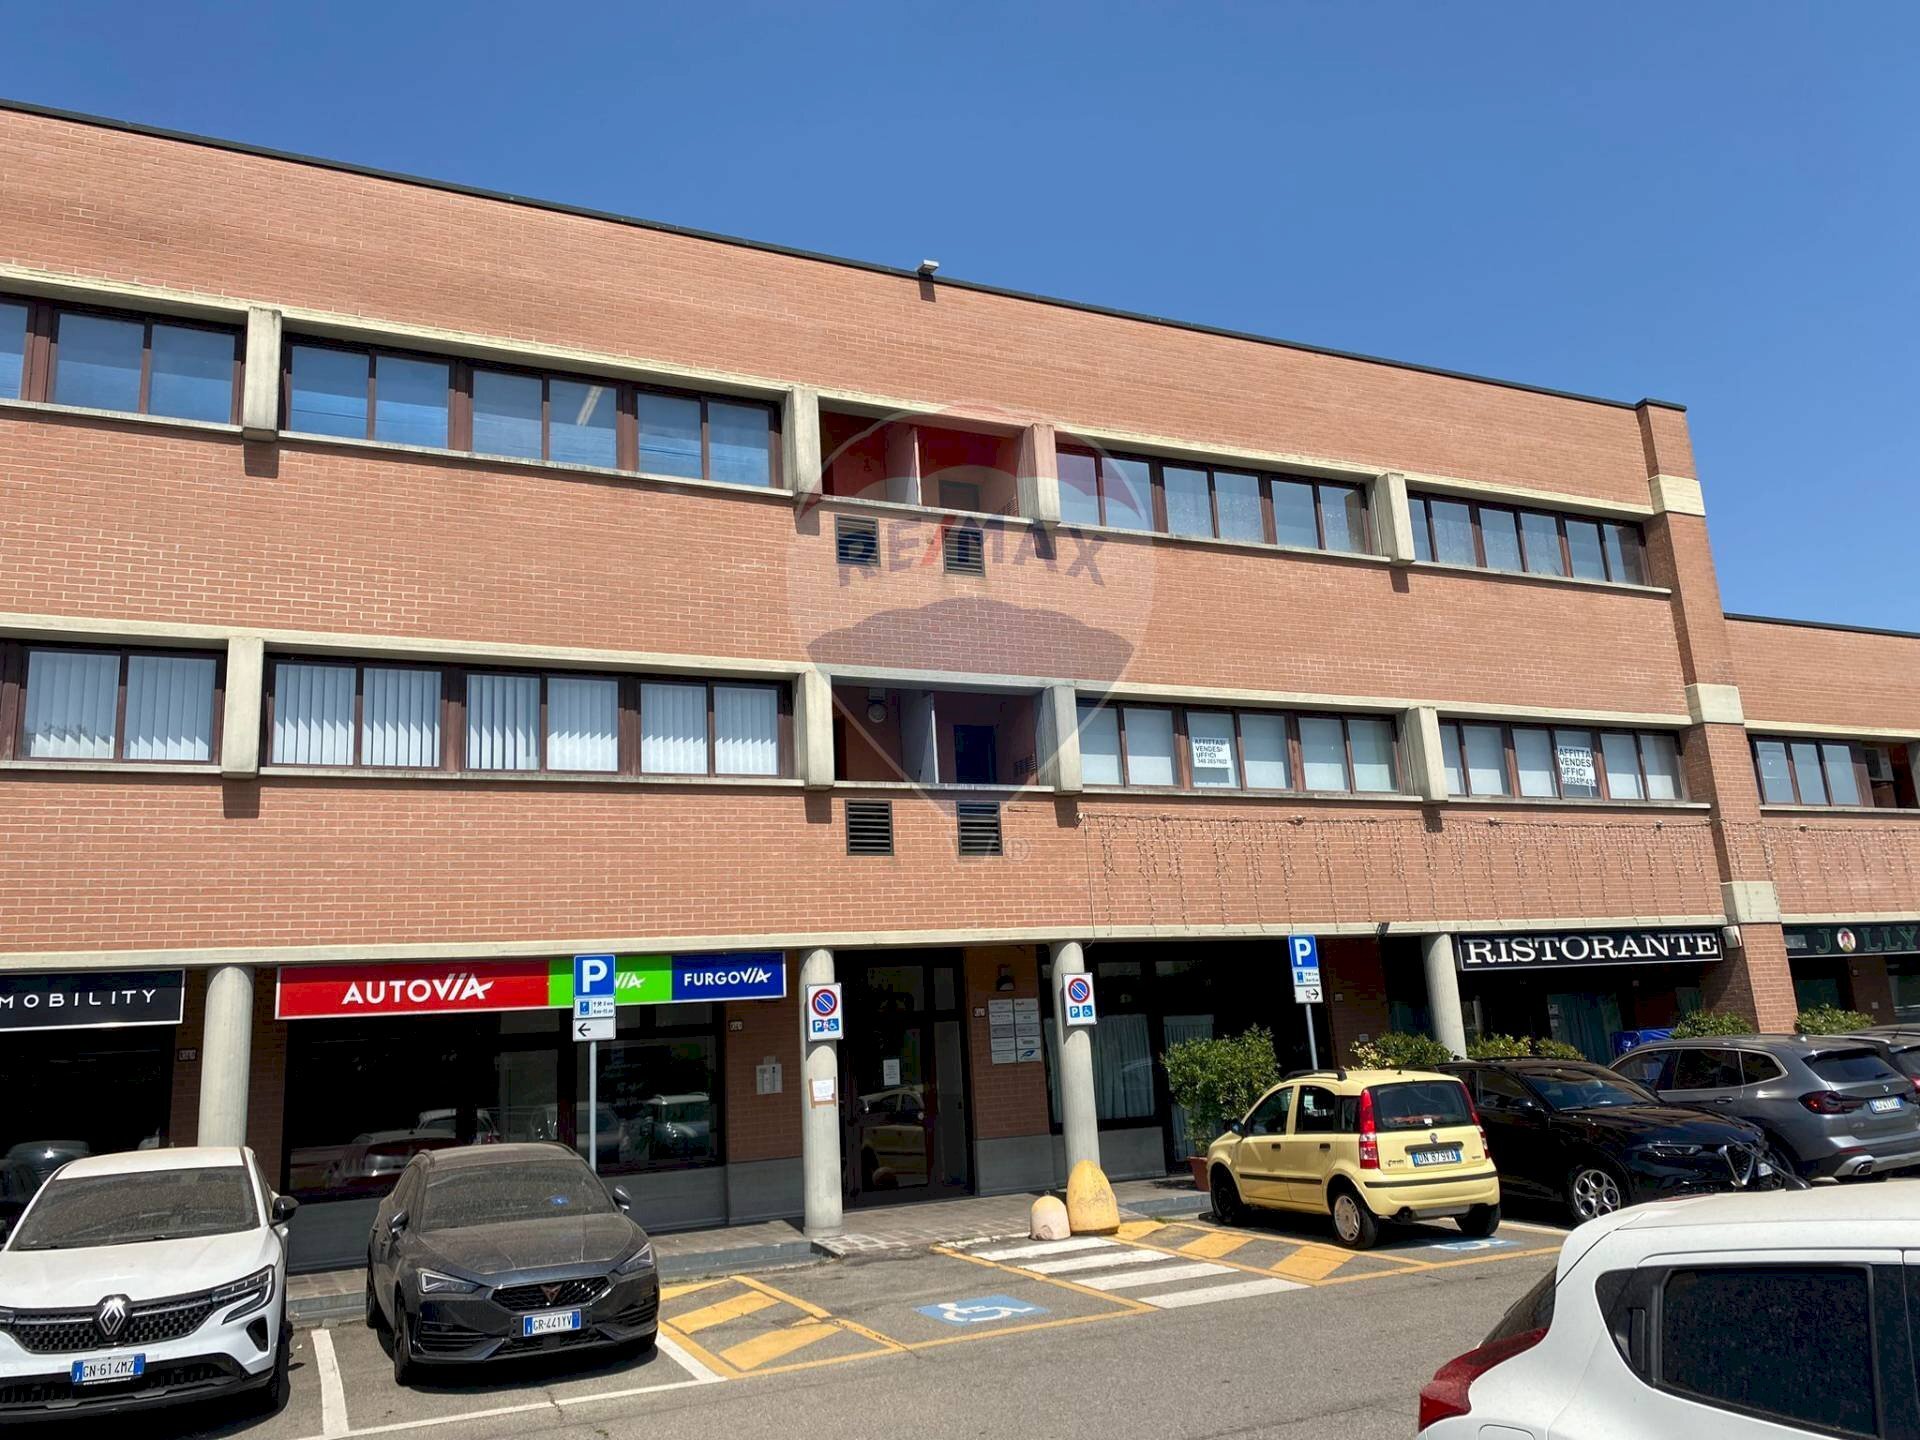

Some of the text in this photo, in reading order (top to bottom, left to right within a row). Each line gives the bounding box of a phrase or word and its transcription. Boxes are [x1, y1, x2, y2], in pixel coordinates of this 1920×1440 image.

[1561, 767, 1586, 776] UFFICI
[1294, 938, 1312, 966] P
[1464, 932, 1718, 964] RISTORANTE
[341, 973, 495, 1005] AUTOVIA
[582, 959, 608, 993] P
[683, 967, 772, 987] FURGOVIA
[0, 989, 156, 1009] MOBILITY
